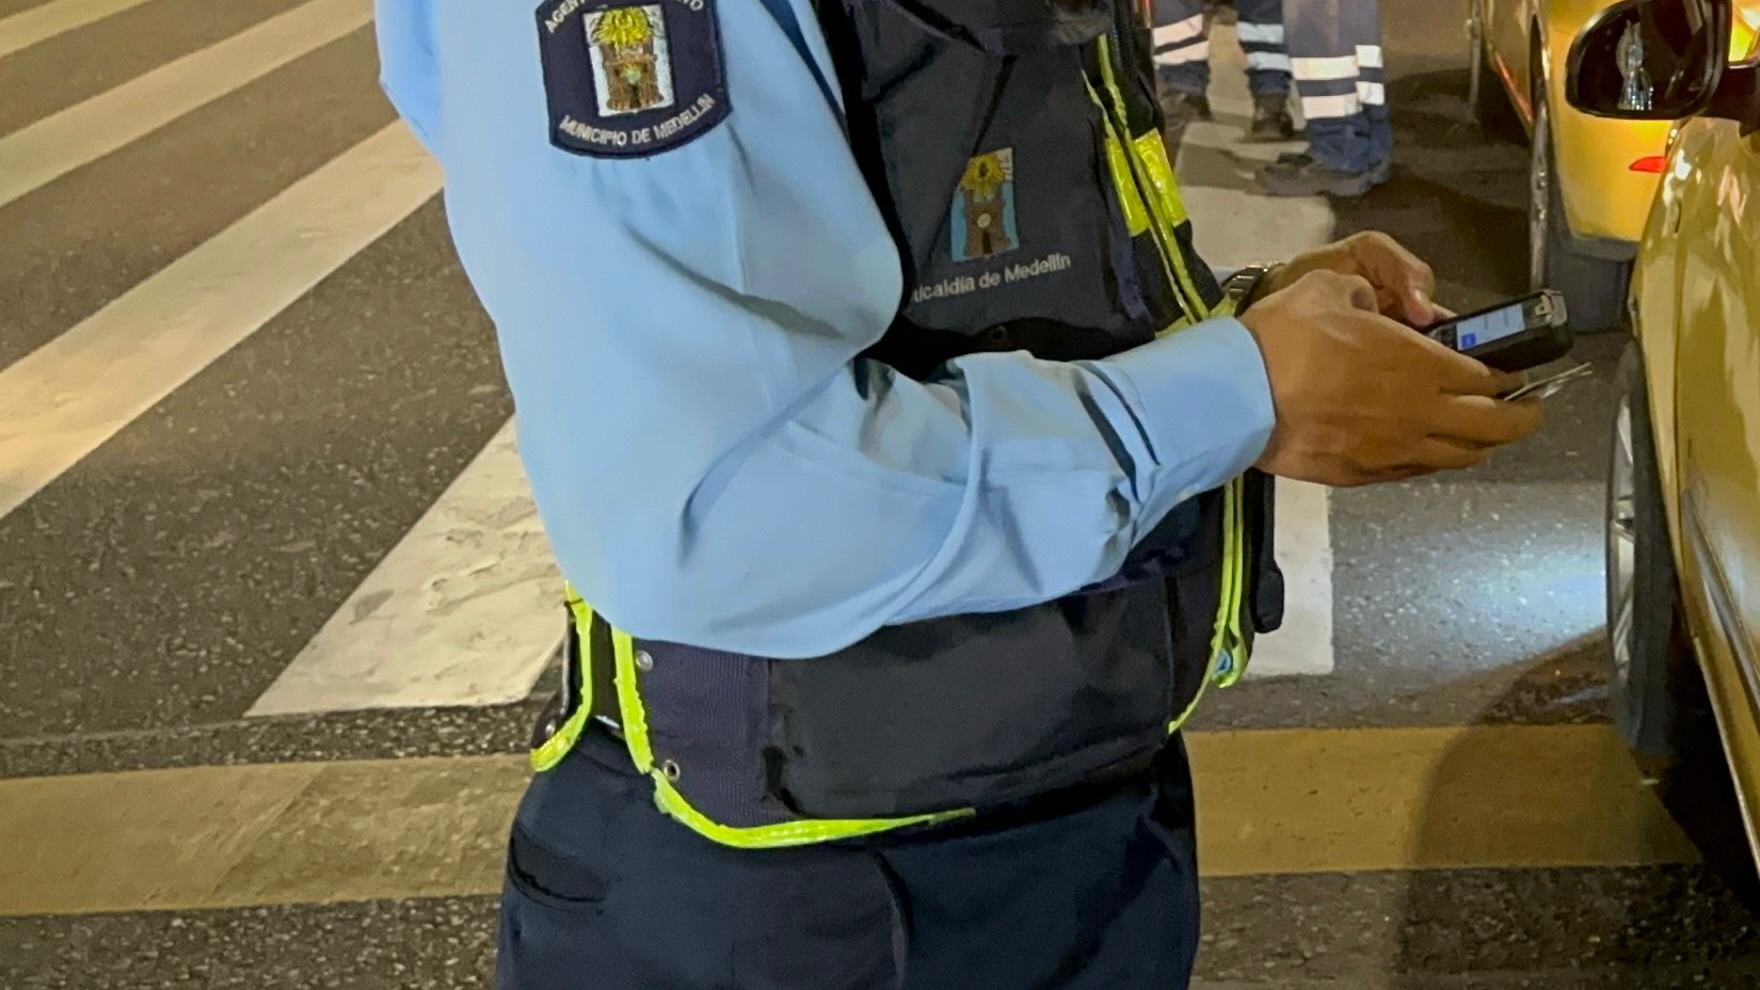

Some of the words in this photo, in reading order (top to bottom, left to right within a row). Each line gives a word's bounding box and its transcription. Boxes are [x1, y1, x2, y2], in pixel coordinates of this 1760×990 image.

[559, 114, 628, 146] MUNICIPIO
[632, 127, 652, 145] DE
[979, 271, 1001, 289] de
